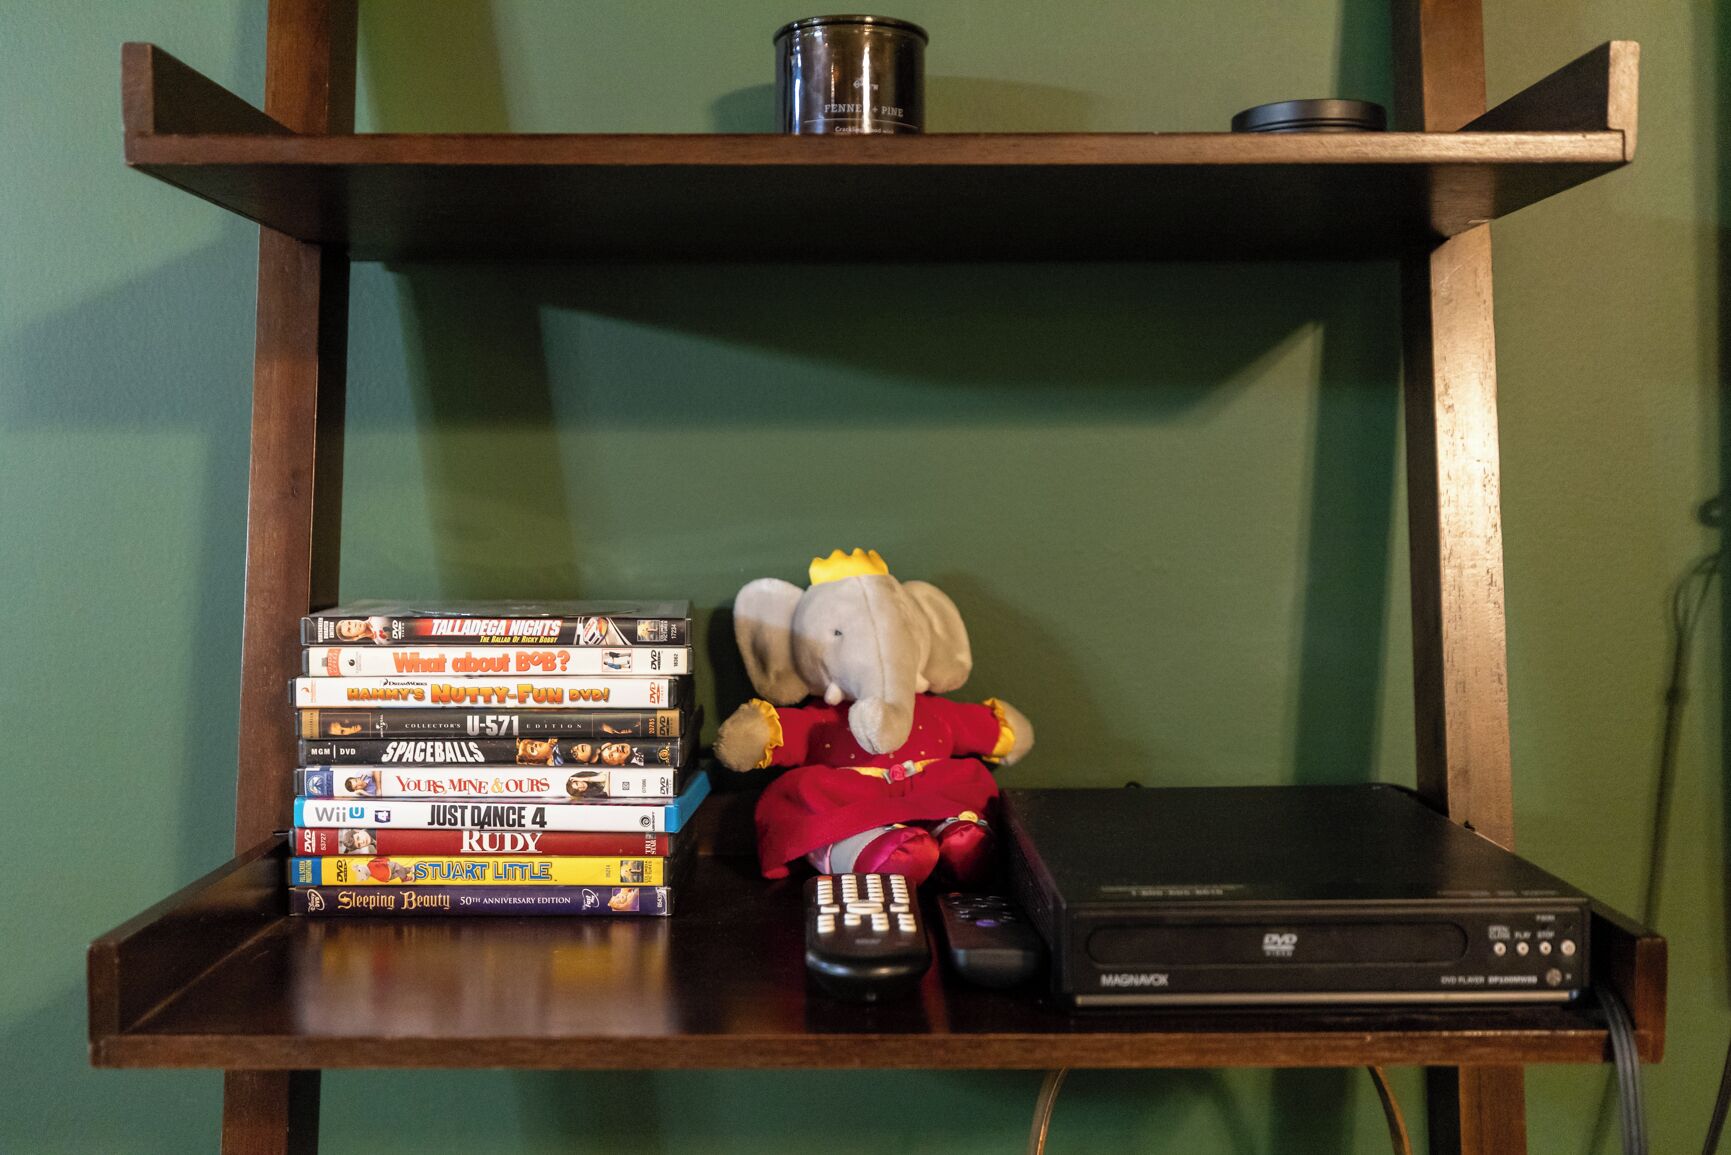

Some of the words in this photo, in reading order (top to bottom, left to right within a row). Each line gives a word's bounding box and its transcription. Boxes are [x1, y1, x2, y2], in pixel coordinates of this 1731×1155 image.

[824, 103, 867, 113] FENNE
[881, 106, 904, 117] PINE
[431, 618, 505, 636] TALLADEGA
[510, 619, 562, 636] NIGHTS
[393, 651, 447, 673] What
[452, 650, 510, 673] about
[346, 687, 424, 701] HAMMY'S
[431, 684, 564, 704] NUTTY-FUN
[569, 687, 610, 702] DVD!
[466, 714, 519, 736] U-571
[381, 741, 485, 763] SPACEBALLS
[396, 776, 447, 796] YOURS,
[448, 778, 488, 794] MINE
[490, 778, 504, 794] &
[506, 778, 550, 792] OURS
[315, 806, 346, 822] Wii
[350, 806, 362, 817] U
[428, 804, 468, 827] JUST
[470, 806, 526, 829] DANCE
[531, 806, 547, 828] 4
[460, 830, 542, 854] RUDY
[415, 861, 490, 881] STUART
[493, 861, 553, 881] LITTLE
[337, 890, 395, 910] Sleeping
[400, 890, 450, 909] Beauty
[460, 896, 481, 906] 50TH
[482, 896, 536, 904] ANNIVERSARY
[1264, 933, 1297, 945] DVD
[1101, 974, 1169, 986] MAGNAVOX
[1441, 976, 1456, 984] DVD
[1458, 976, 1484, 984] PLAYER
